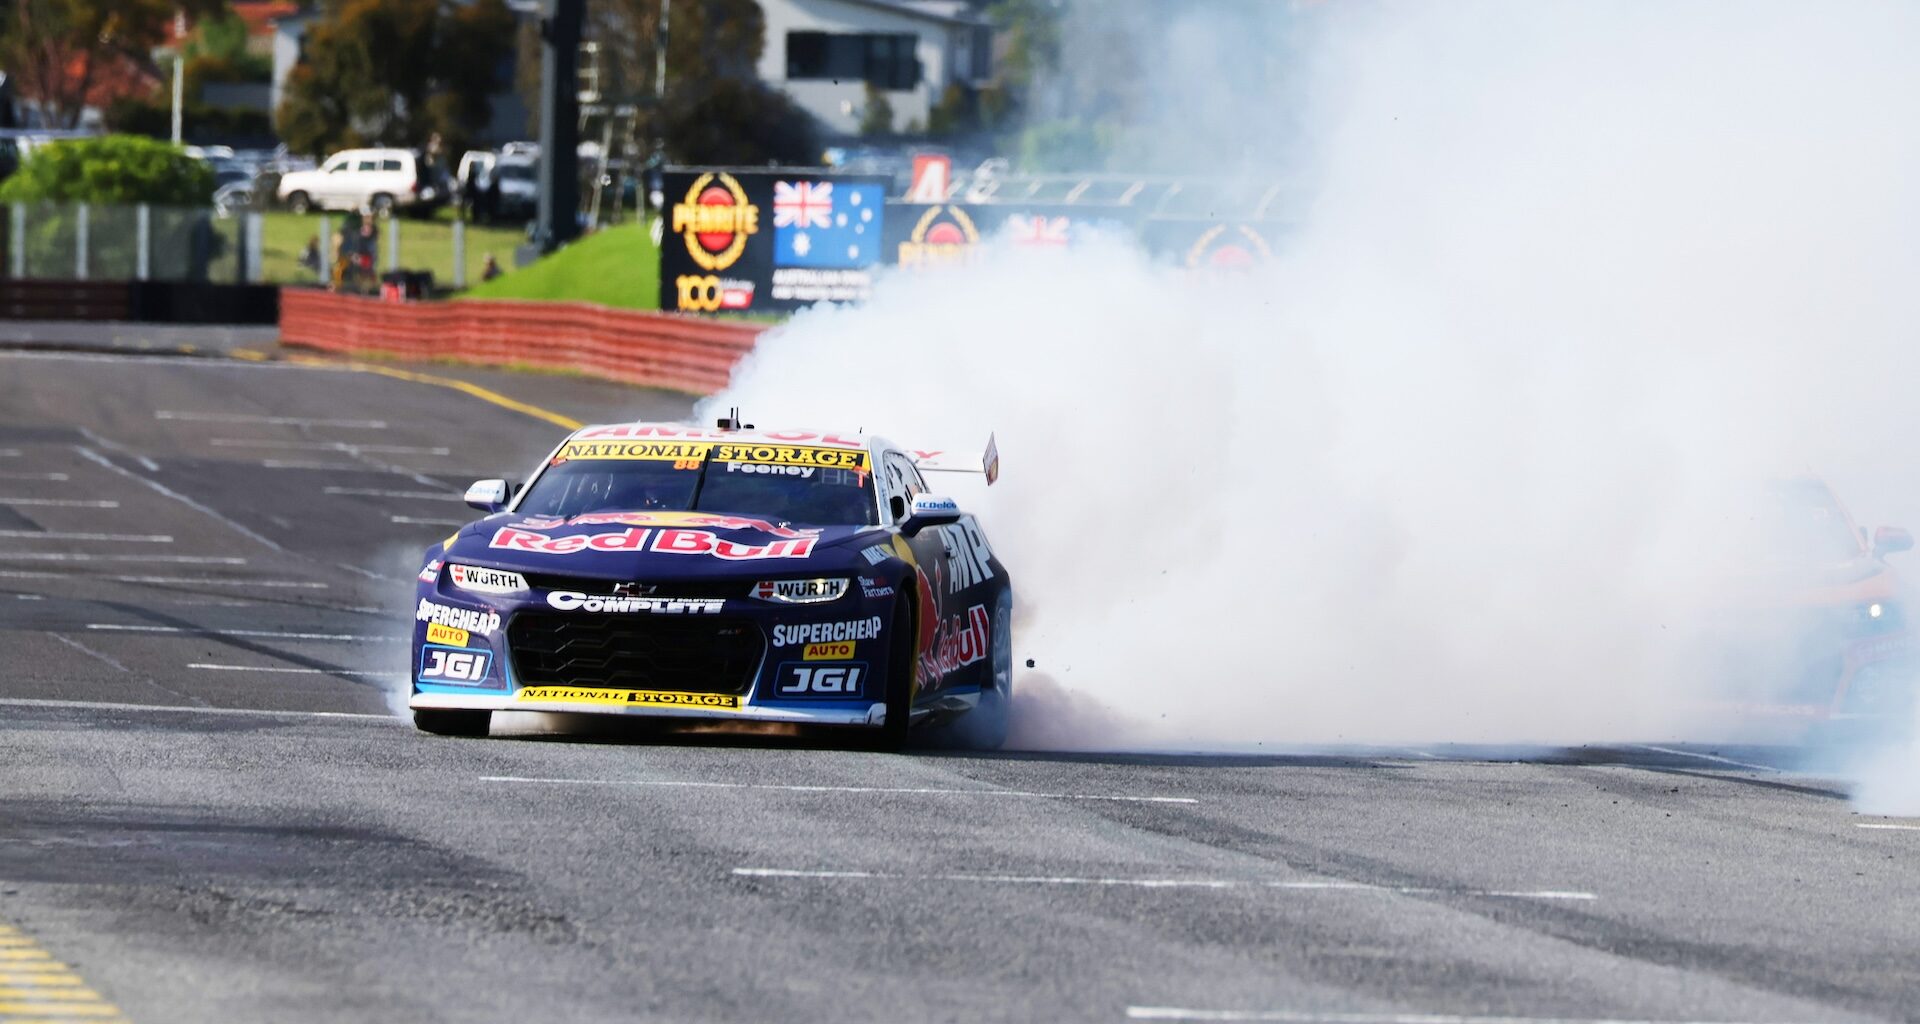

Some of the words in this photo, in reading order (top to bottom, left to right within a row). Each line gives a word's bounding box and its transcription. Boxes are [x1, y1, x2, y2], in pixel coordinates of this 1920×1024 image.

[673, 203, 759, 233] PENRITE
[676, 275, 722, 311] 100
[583, 427, 861, 446] AMOL
[566, 444, 701, 457] NATIONAL
[718, 446, 858, 465] STORAGE
[673, 460, 701, 470] 88
[726, 461, 816, 478] Feeney
[488, 527, 652, 554] Red
[650, 529, 820, 559] Bull
[466, 570, 519, 588] WÜRTH
[778, 581, 840, 596] WÜRTH
[546, 590, 725, 614] COMPLETE
[431, 628, 463, 642] AUTO
[773, 616, 882, 647] SUPERCHEAP
[808, 645, 850, 656] AUTO
[423, 651, 485, 680] JGI
[782, 668, 861, 692] JGI
[523, 689, 624, 700] NATIONAL
[634, 692, 734, 706] STORAGE
